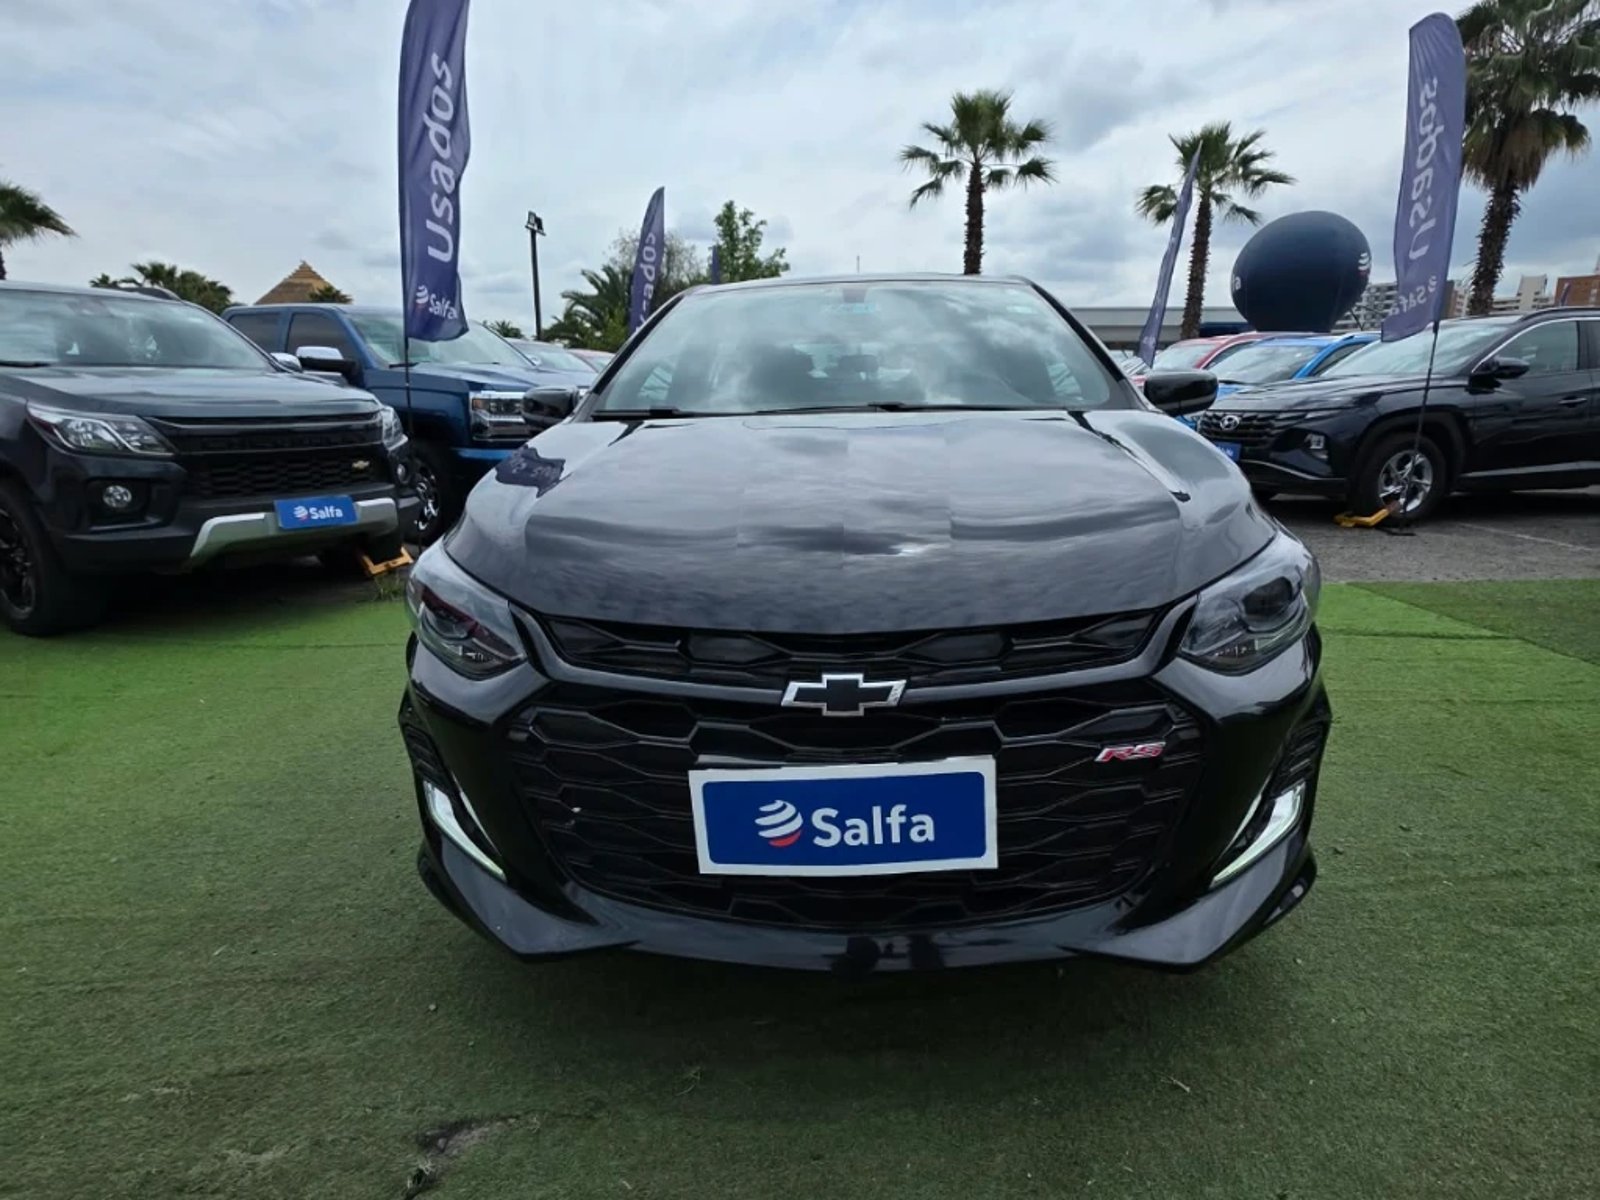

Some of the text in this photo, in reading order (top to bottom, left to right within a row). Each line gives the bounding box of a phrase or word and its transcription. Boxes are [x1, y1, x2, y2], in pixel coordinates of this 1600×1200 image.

[422, 52, 457, 263] Usados
[429, 293, 458, 320] Salfa
[309, 505, 343, 520] Salfa
[1095, 742, 1166, 762] RS
[813, 804, 935, 847] Salfa
